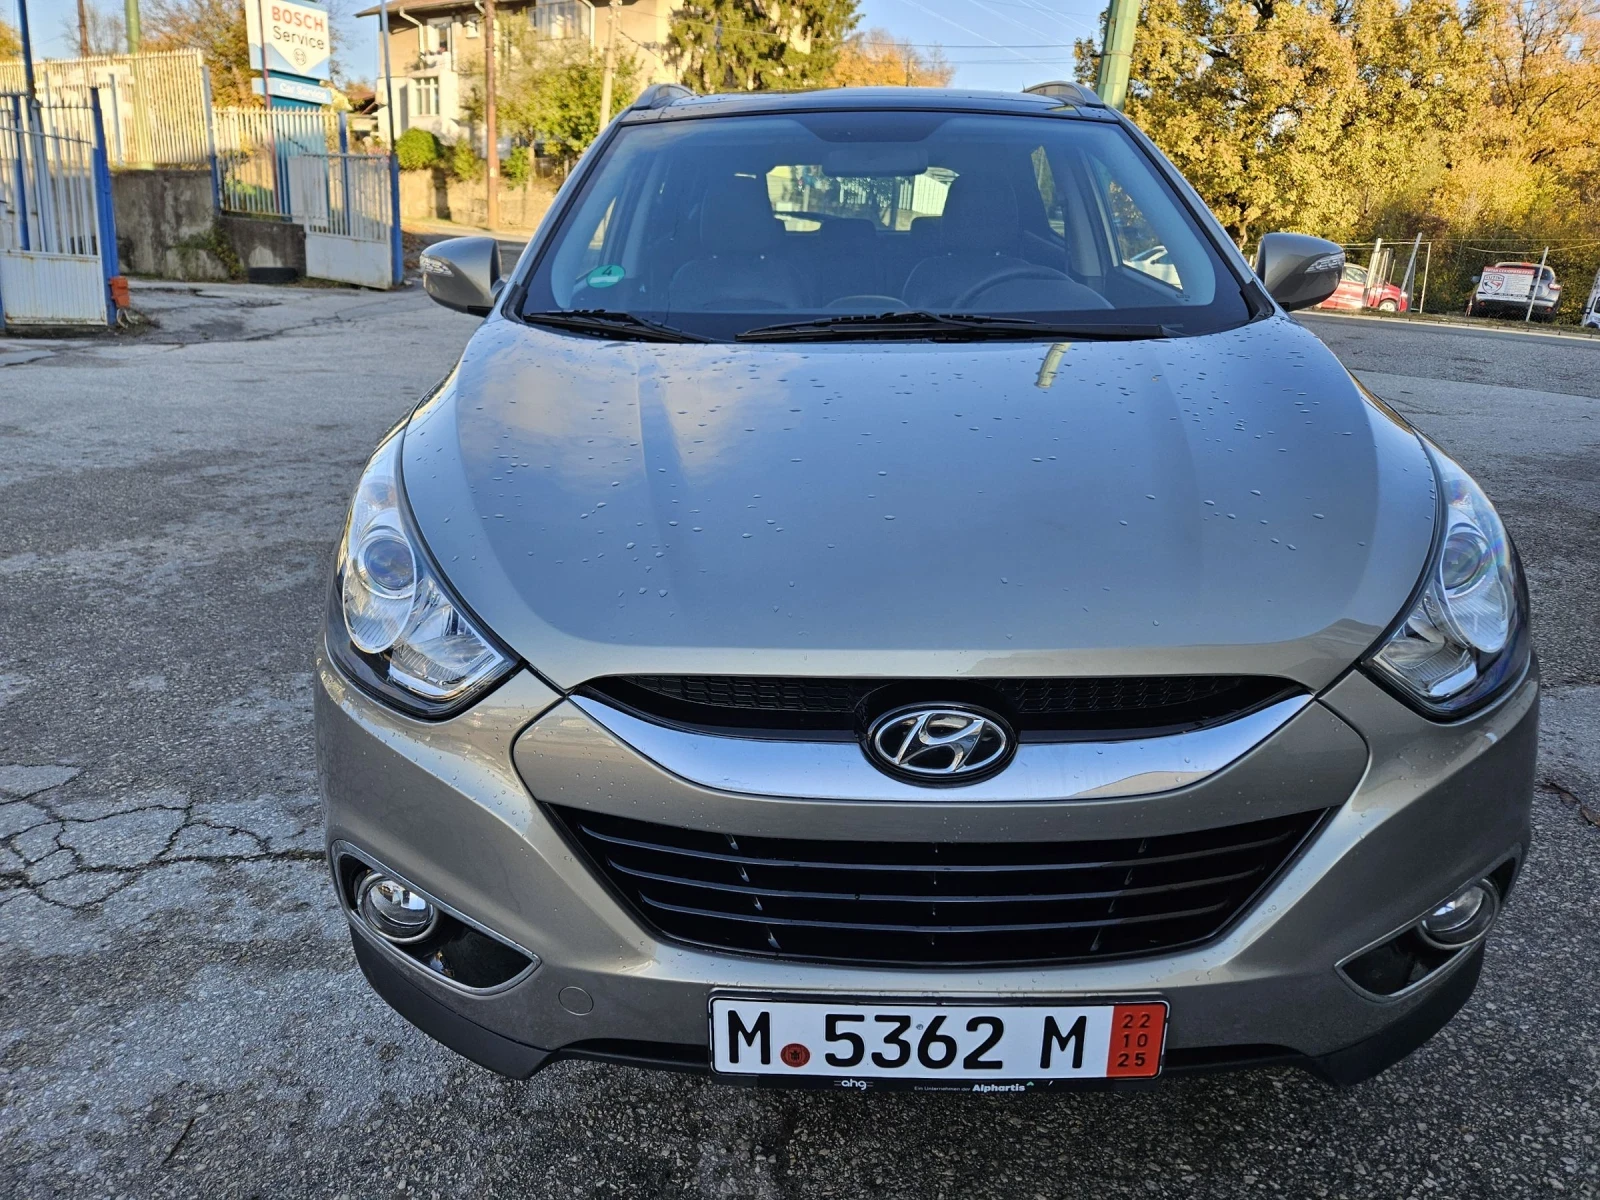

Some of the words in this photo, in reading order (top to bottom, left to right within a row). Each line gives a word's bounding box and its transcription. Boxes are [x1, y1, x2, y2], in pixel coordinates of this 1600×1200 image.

[271, 5, 325, 32] BOSCH
[272, 25, 325, 50] Service
[601, 265, 613, 277] 4
[1121, 1013, 1151, 1029] 22
[727, 1009, 771, 1066] M
[824, 1013, 1005, 1070] 5362
[1039, 1015, 1087, 1069] M
[1122, 1032, 1148, 1048] 10
[1117, 1052, 1146, 1068] 25
[841, 1078, 867, 1091] ahg
[972, 1083, 1026, 1093] Alphartis
